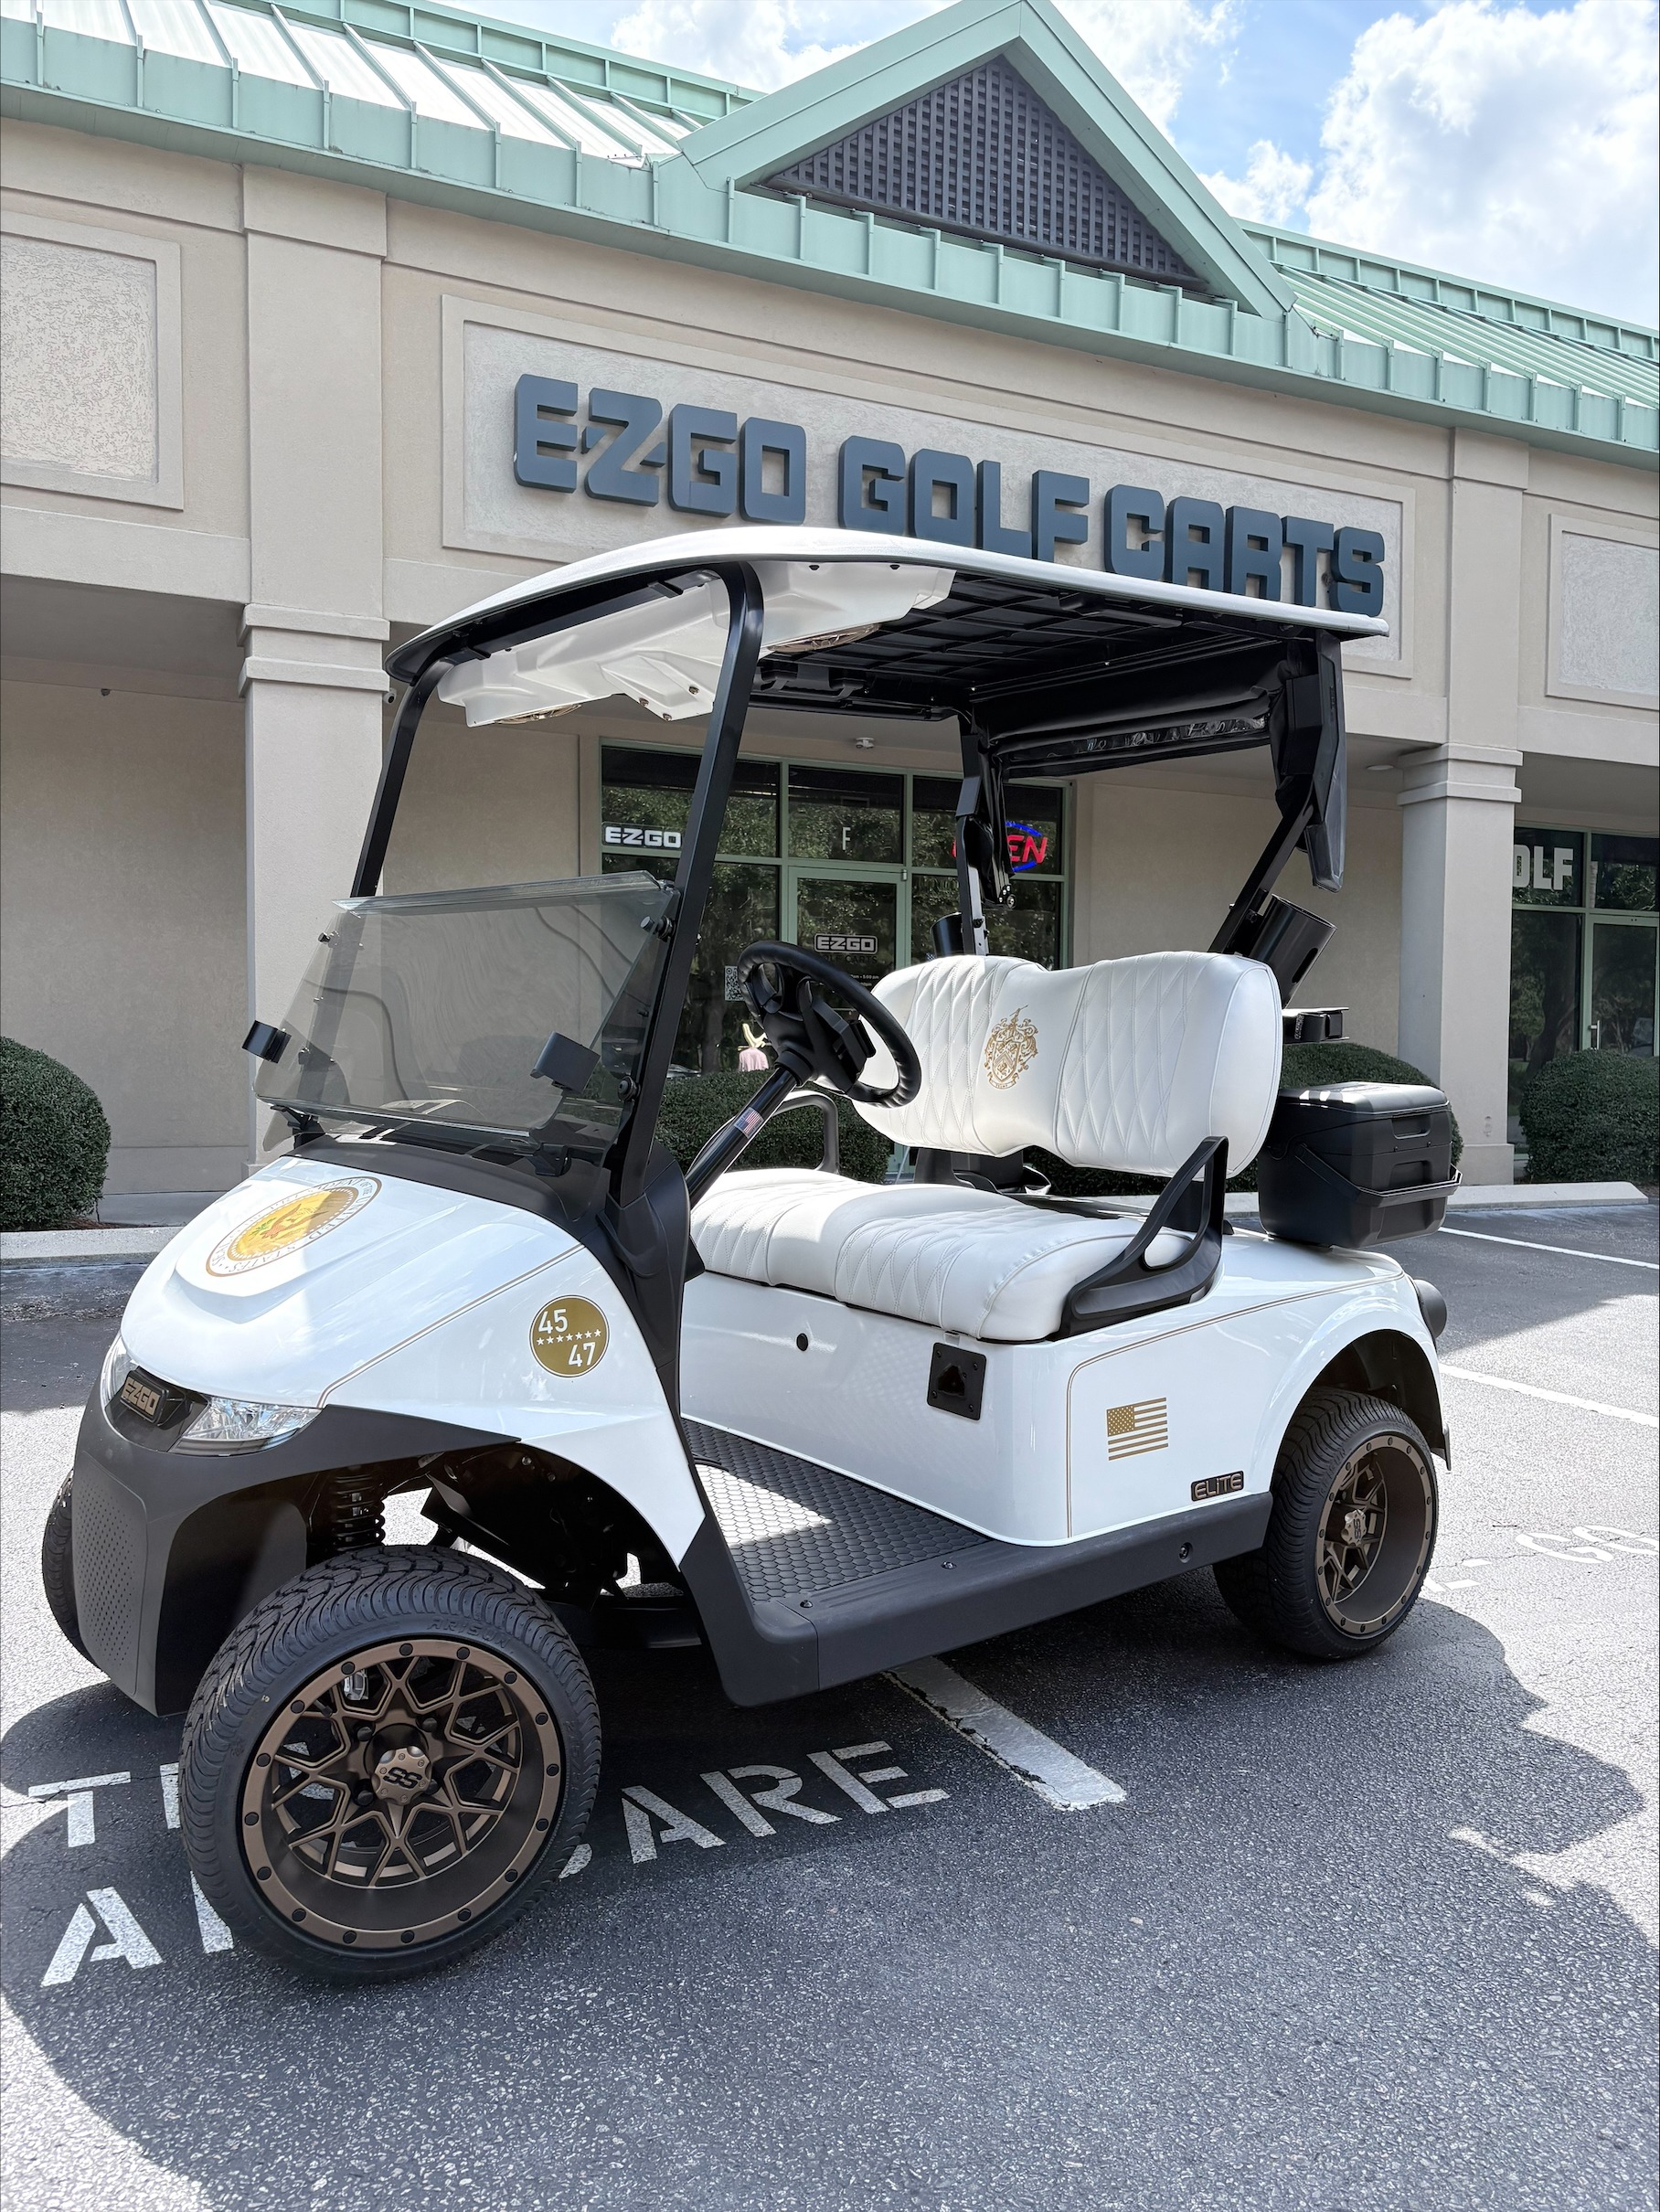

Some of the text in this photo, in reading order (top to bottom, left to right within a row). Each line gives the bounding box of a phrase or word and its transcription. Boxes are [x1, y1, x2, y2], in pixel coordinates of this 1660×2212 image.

[514, 374, 1385, 617] EZGO GOLF CARTS
[605, 826, 682, 849] EZGO
[842, 826, 851, 851] F
[816, 936, 875, 952] EZGO
[538, 1308, 568, 1335] 45
[568, 1342, 596, 1367] 47
[121, 1376, 161, 1416] EZGO
[383, 1767, 422, 1789] SS
